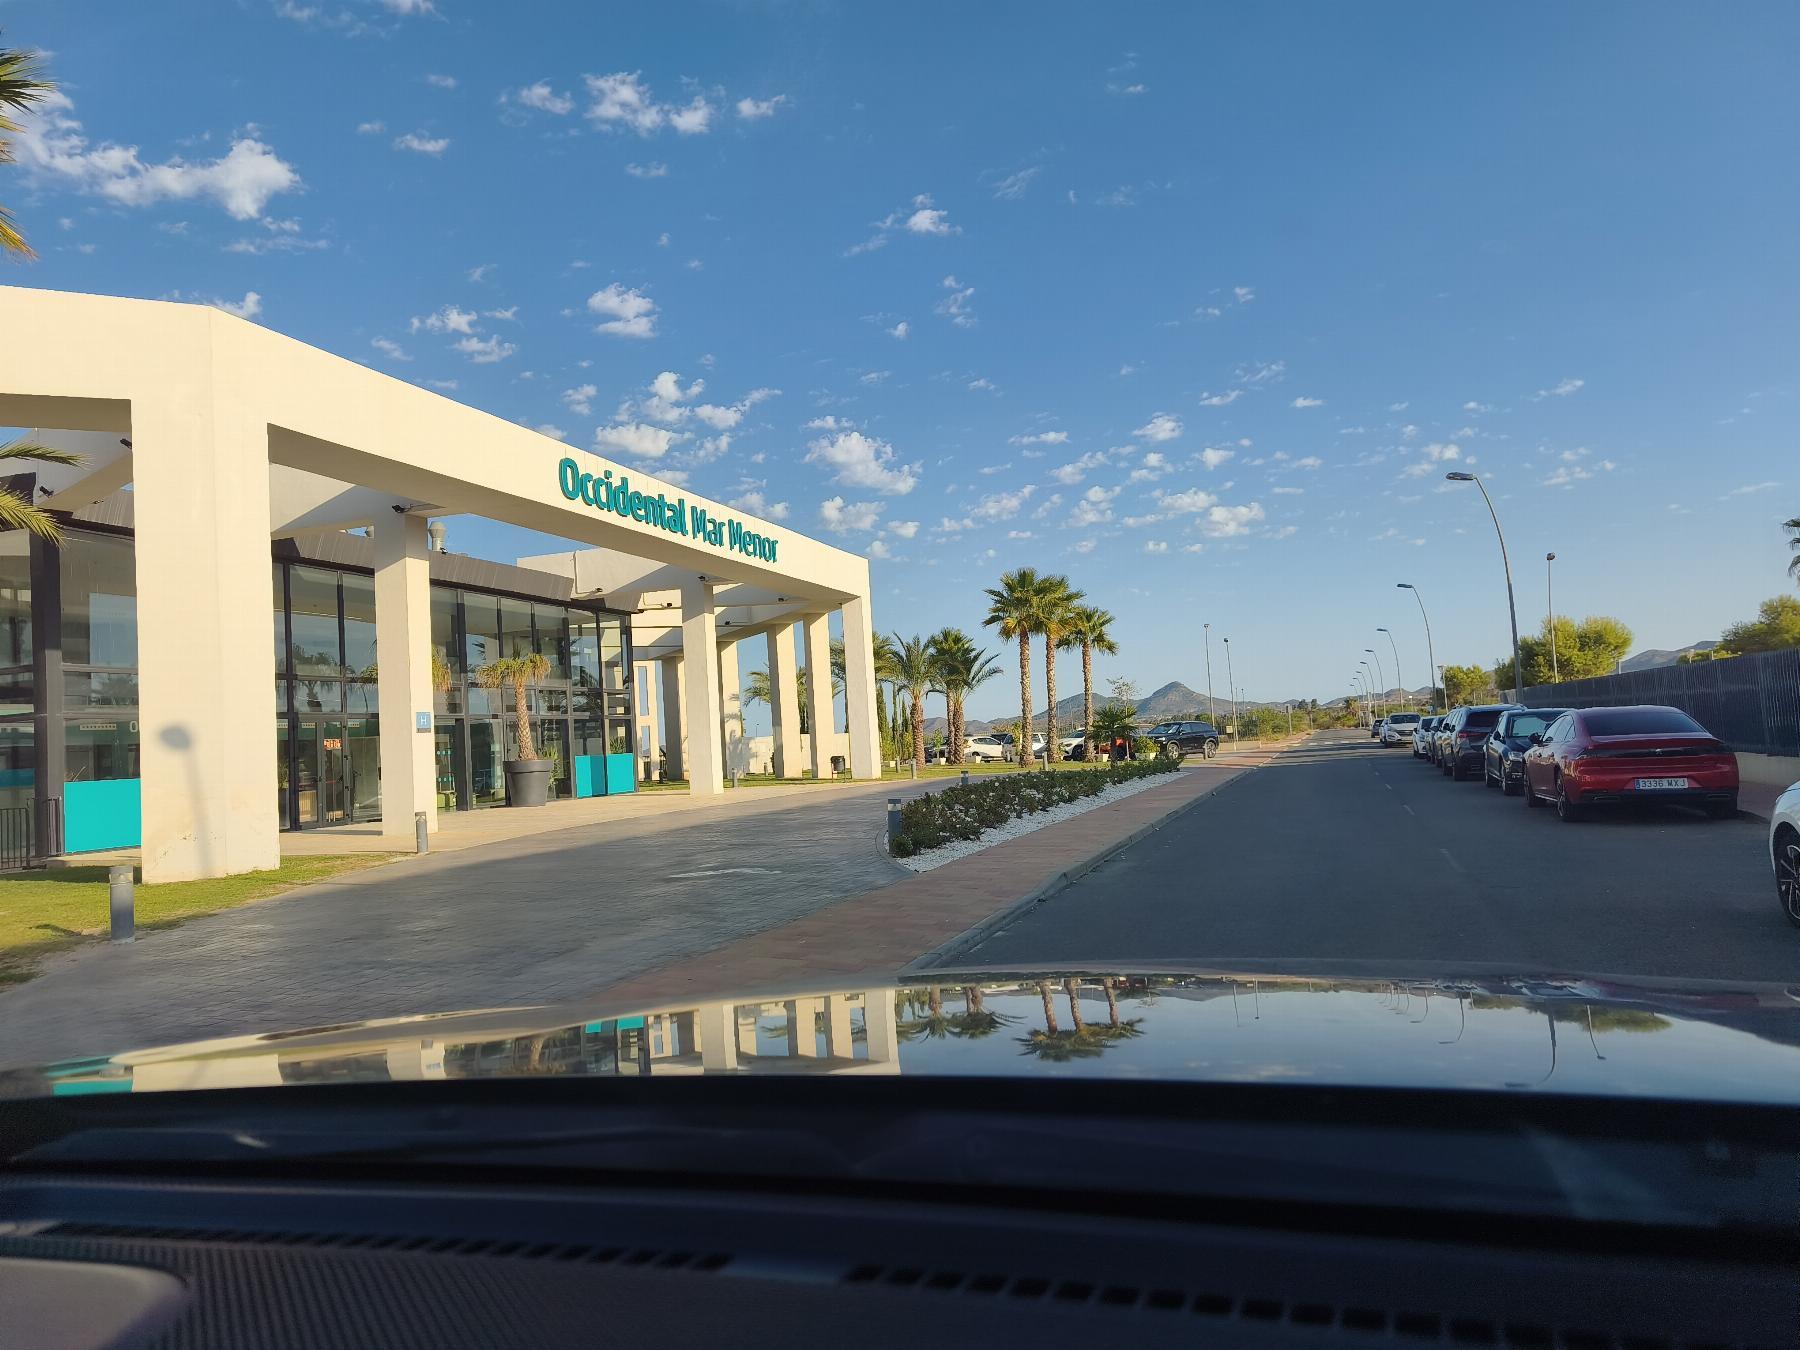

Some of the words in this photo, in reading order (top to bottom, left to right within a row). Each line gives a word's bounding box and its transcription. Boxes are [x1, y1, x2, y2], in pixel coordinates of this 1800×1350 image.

[559, 457, 688, 536] Occidental
[691, 506, 726, 547] Mar
[728, 519, 778, 563] Menor
[1641, 780, 1664, 788] 3336
[1667, 779, 1686, 787] MXJ
